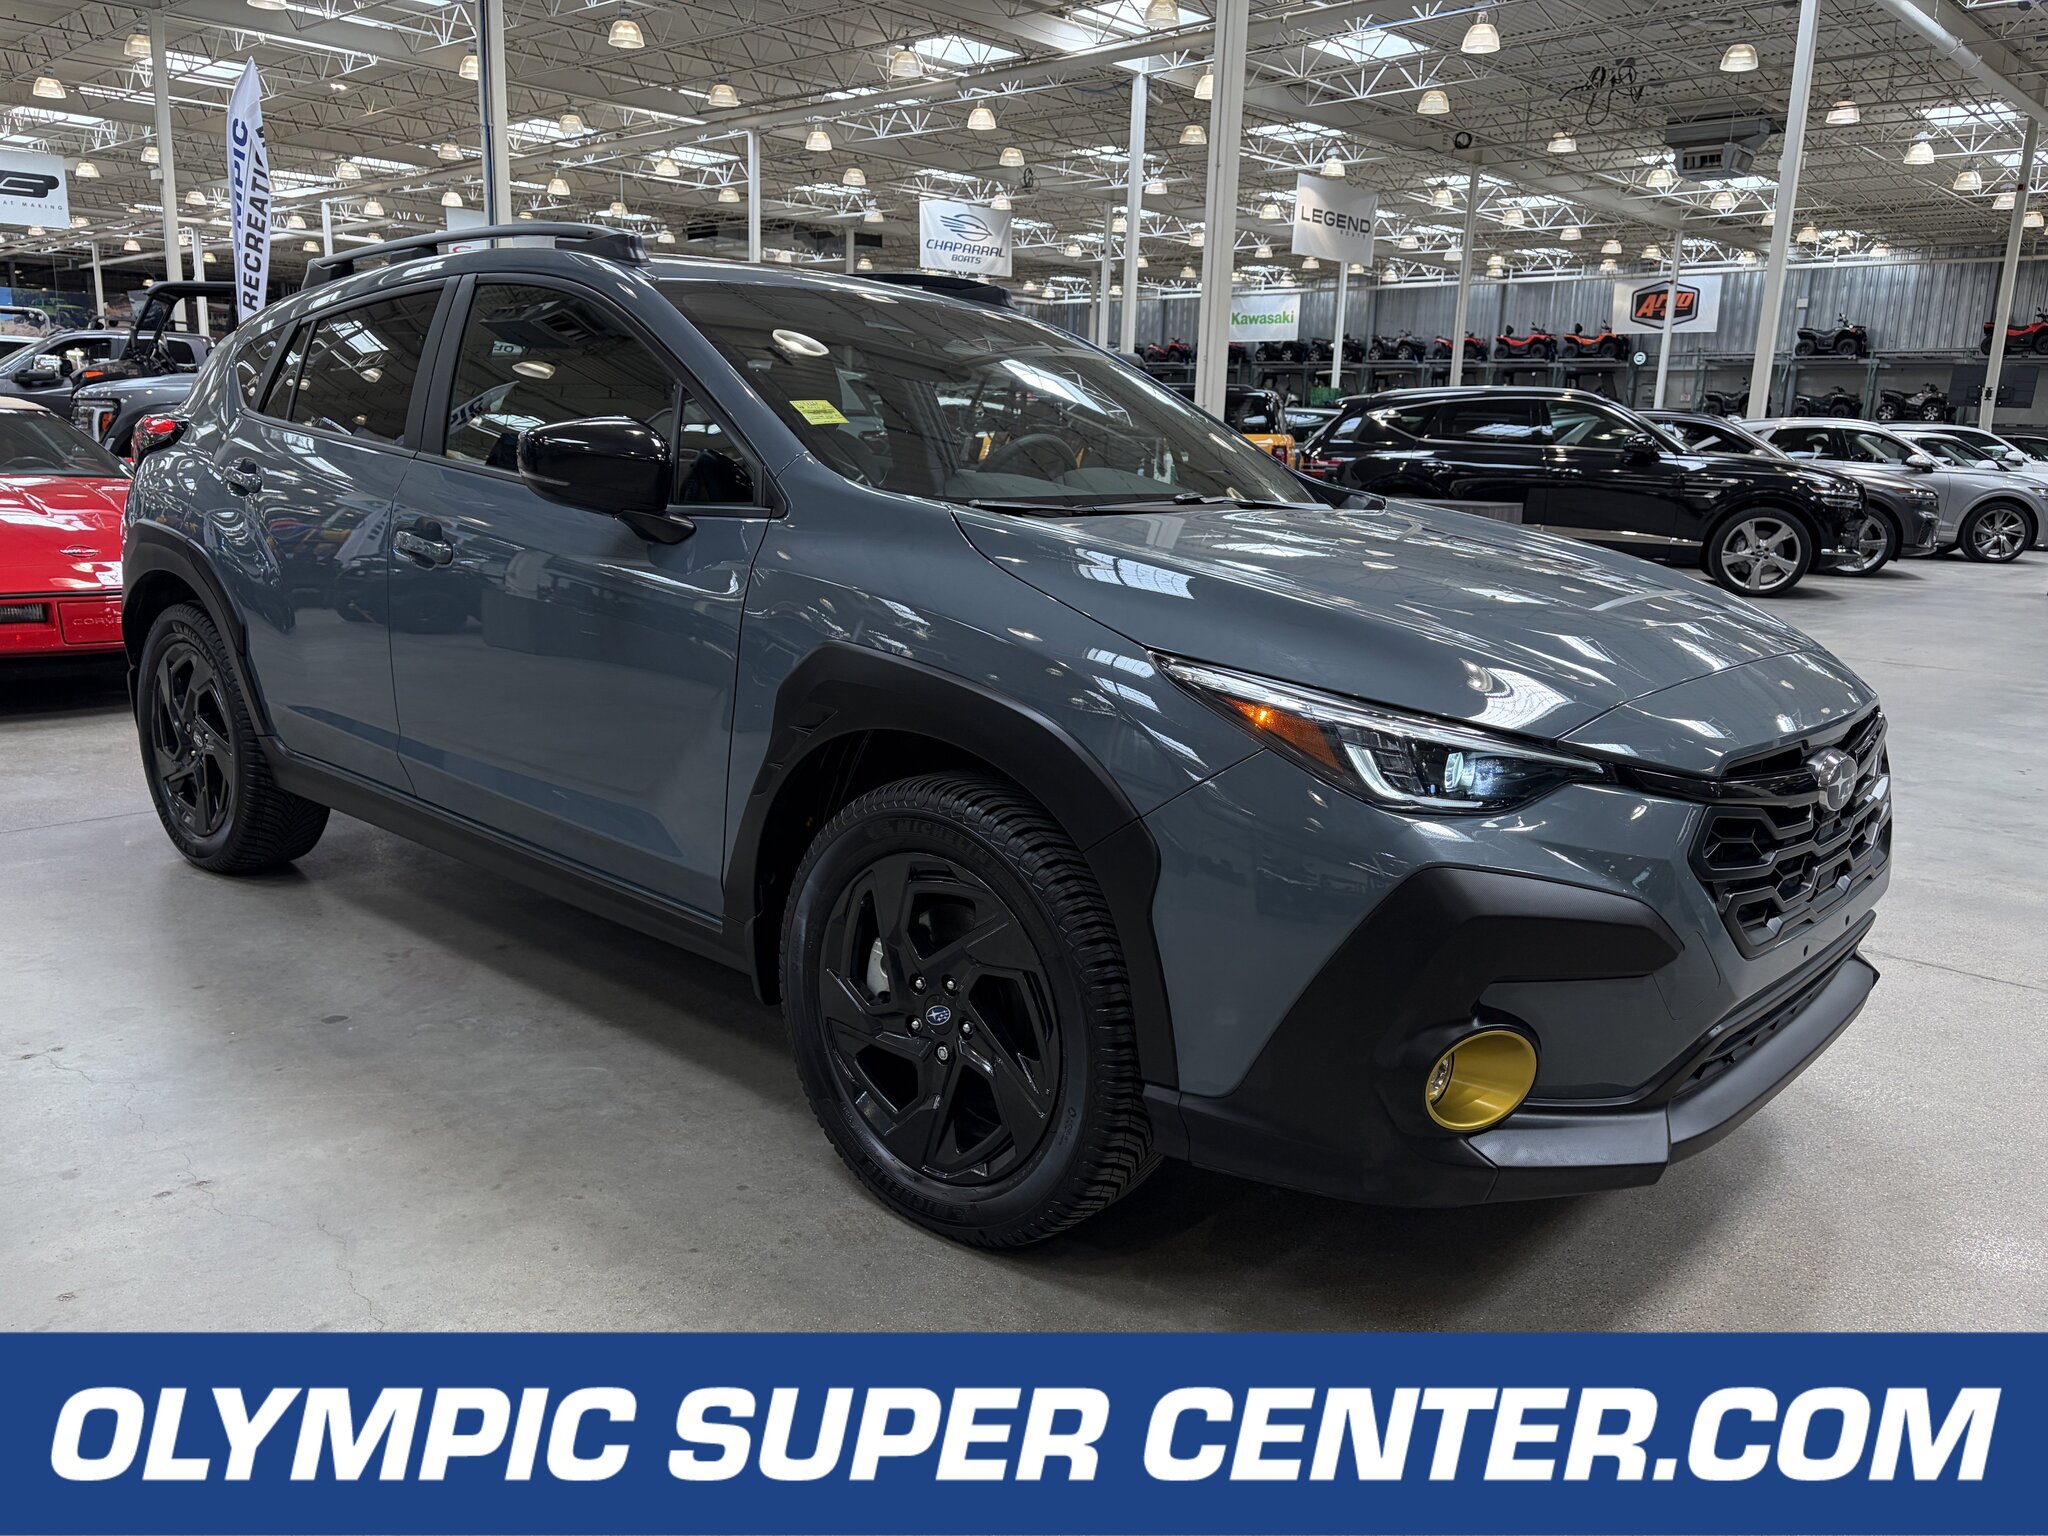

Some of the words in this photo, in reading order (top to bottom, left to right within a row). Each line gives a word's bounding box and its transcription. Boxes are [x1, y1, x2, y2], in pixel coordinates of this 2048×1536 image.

[22, 202, 63, 211] MAKING
[1301, 205, 1371, 234] LEGEND
[926, 238, 1005, 258] CHAPARRAL
[951, 253, 982, 265] BOATS
[1636, 292, 1695, 317] Aro
[1231, 310, 1295, 326] Kawasaki
